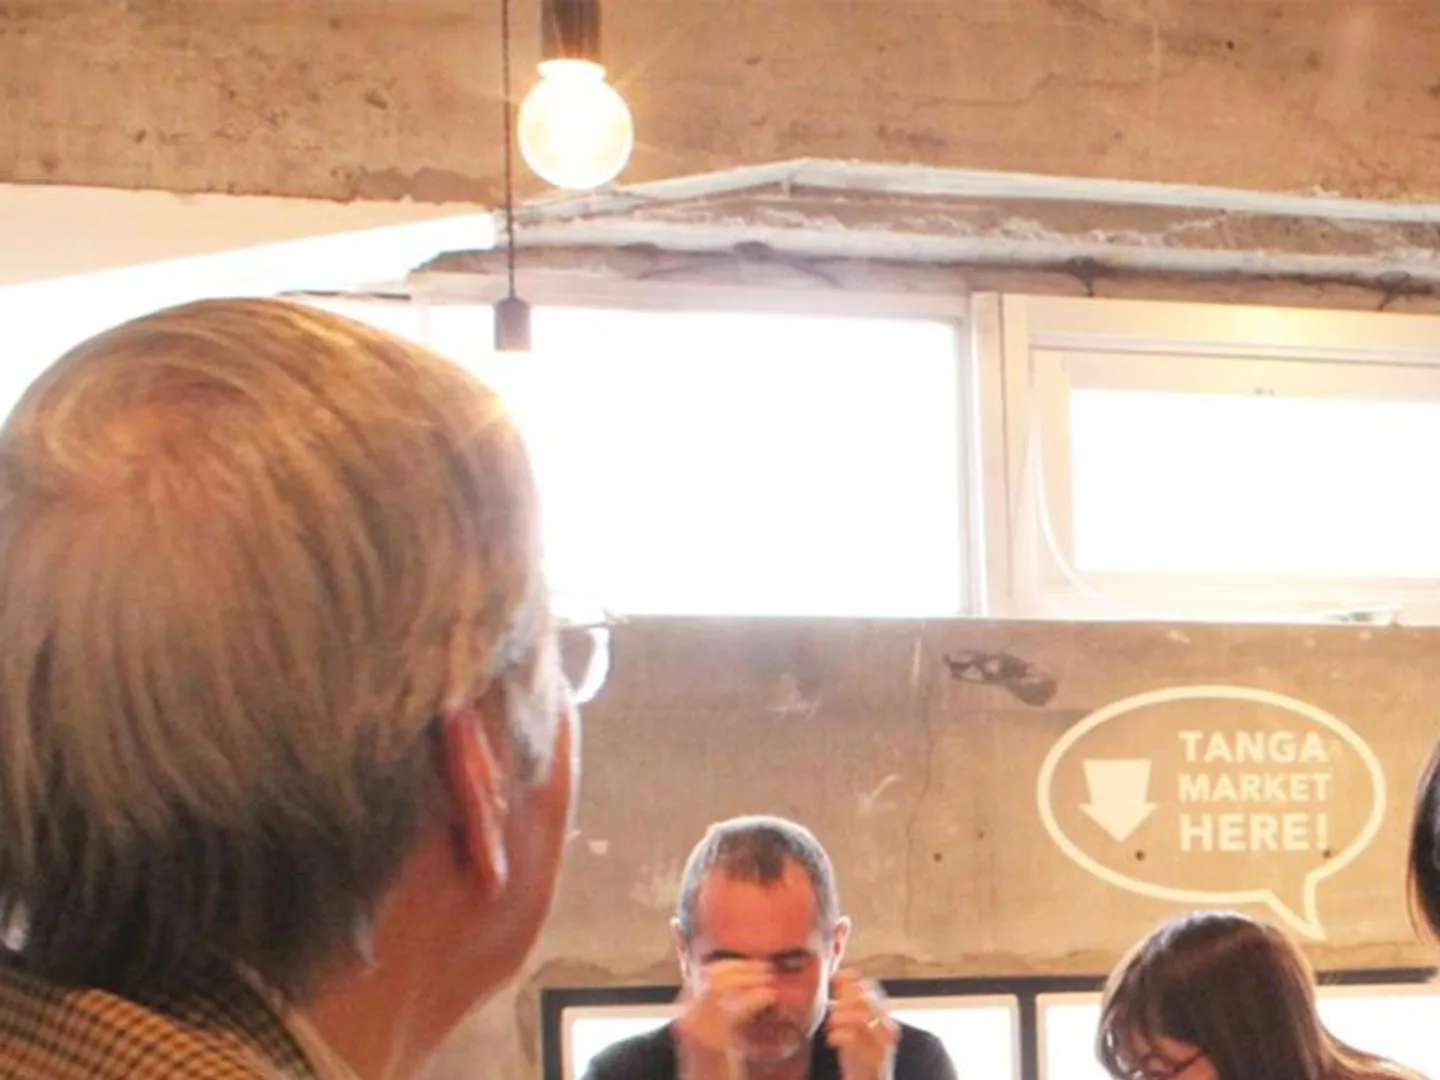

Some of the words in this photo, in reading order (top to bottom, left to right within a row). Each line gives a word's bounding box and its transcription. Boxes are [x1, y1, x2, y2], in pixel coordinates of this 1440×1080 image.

[1179, 731, 1328, 763] TANGA
[1179, 773, 1332, 802] MARKET
[1179, 813, 1330, 852] HERE!
